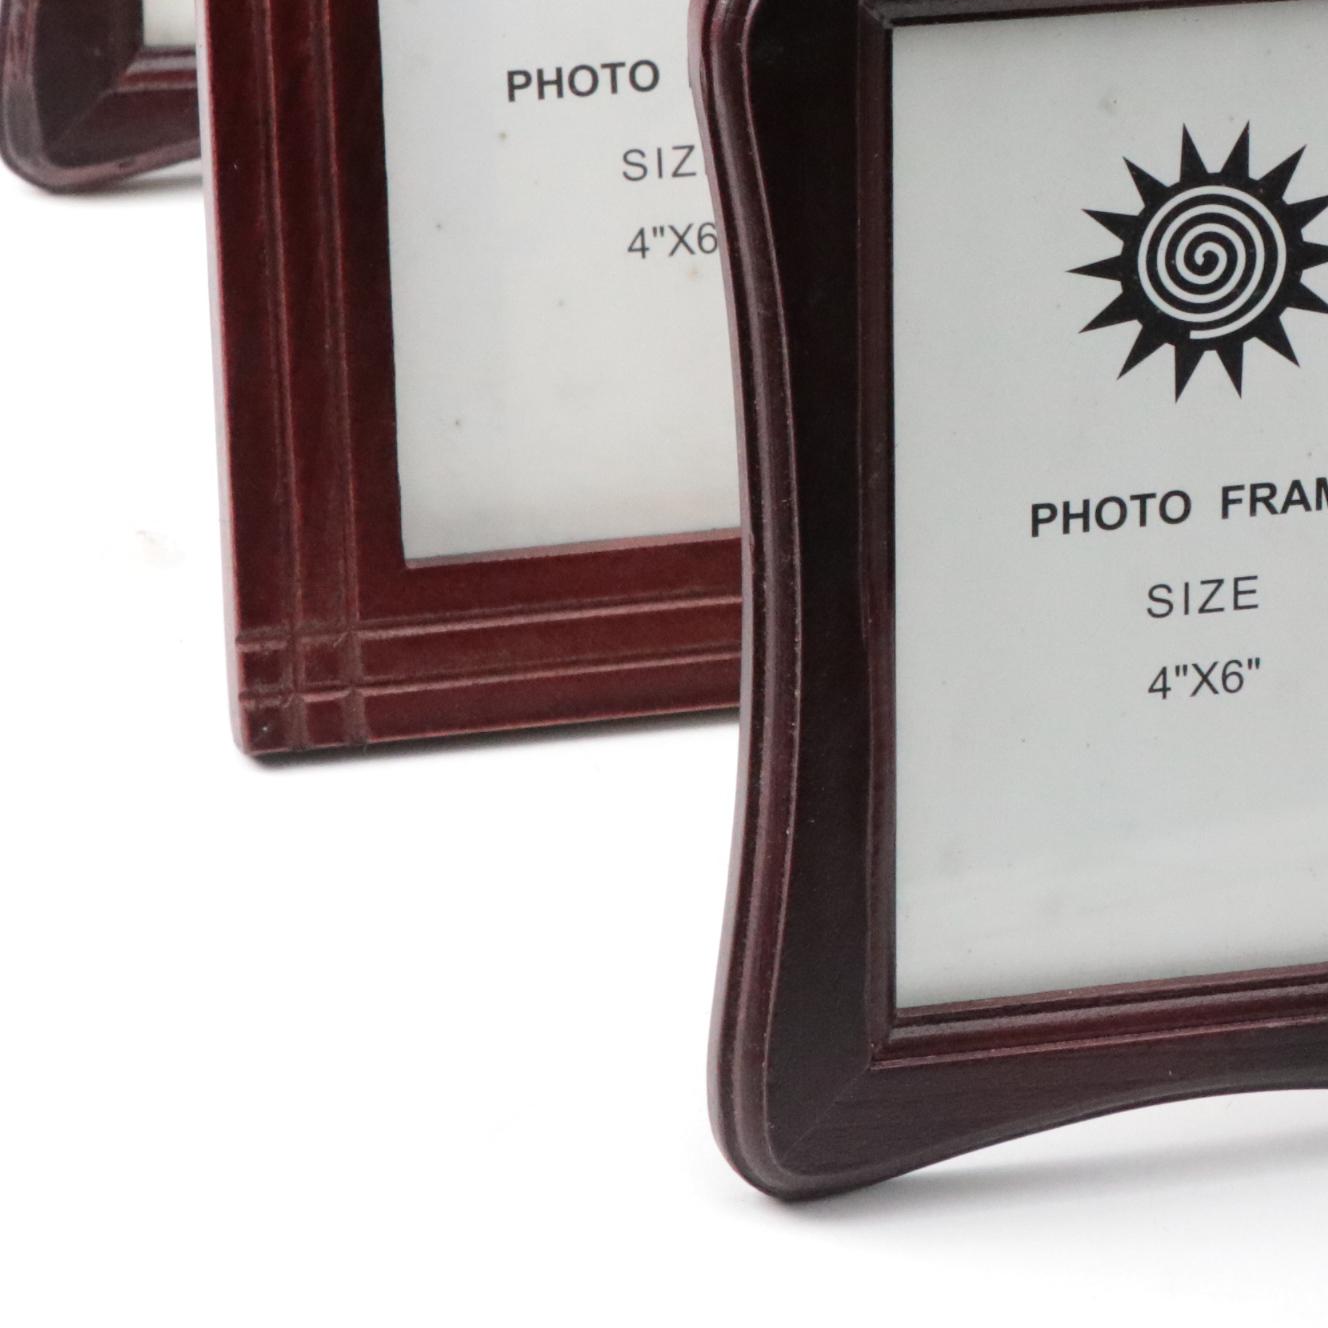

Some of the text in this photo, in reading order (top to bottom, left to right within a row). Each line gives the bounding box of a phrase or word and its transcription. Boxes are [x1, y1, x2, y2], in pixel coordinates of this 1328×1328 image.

[506, 59, 660, 103] PHOTO
[621, 144, 698, 182] SIZ
[626, 222, 719, 259] 4"X6
[1030, 489, 1192, 538] PHOTO
[1146, 575, 1259, 619] SIZE
[1147, 657, 1261, 700] 4"X6"
